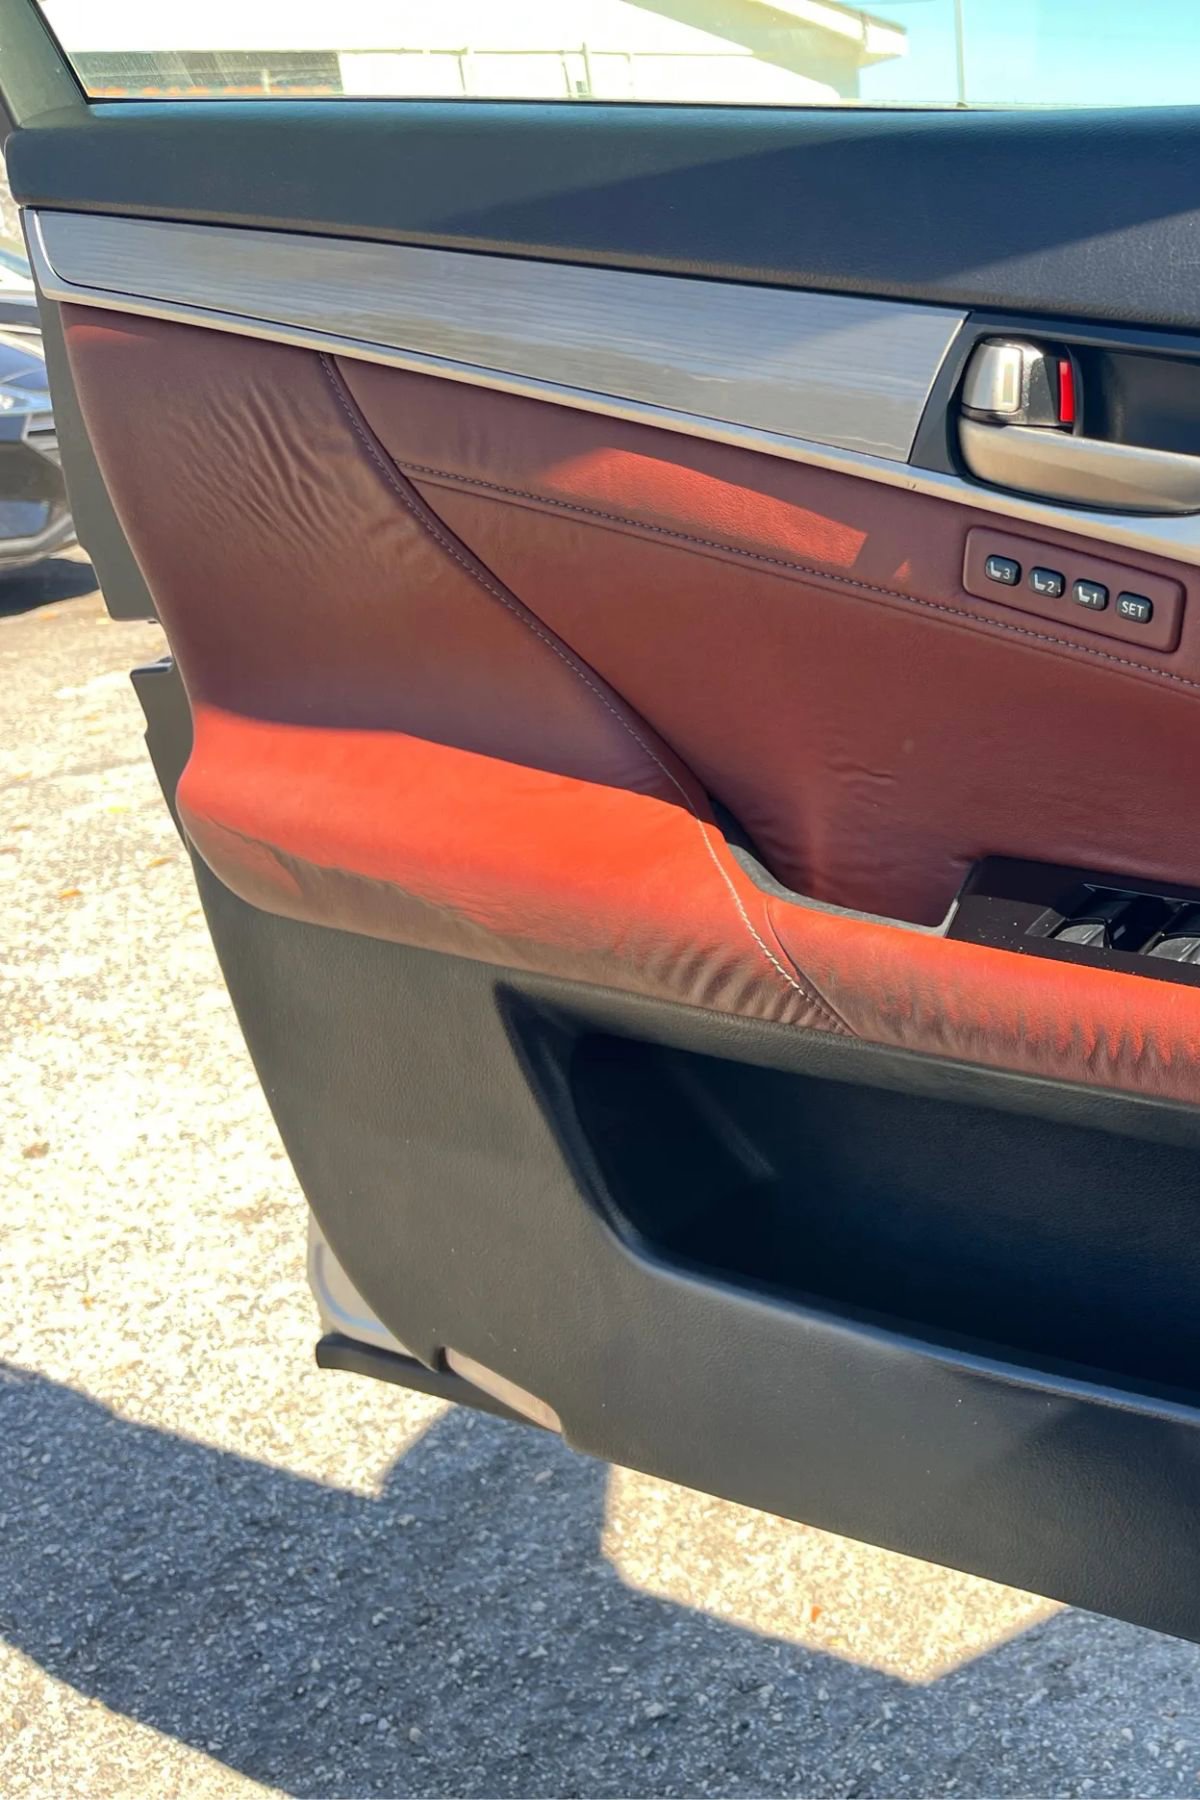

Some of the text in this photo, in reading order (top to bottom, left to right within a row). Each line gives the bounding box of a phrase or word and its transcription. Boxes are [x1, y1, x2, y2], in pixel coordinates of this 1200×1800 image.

[1003, 567, 1011, 580] 3
[1047, 581, 1055, 593] 2
[1091, 593, 1098, 605] 1
[1121, 601, 1144, 618] SET
